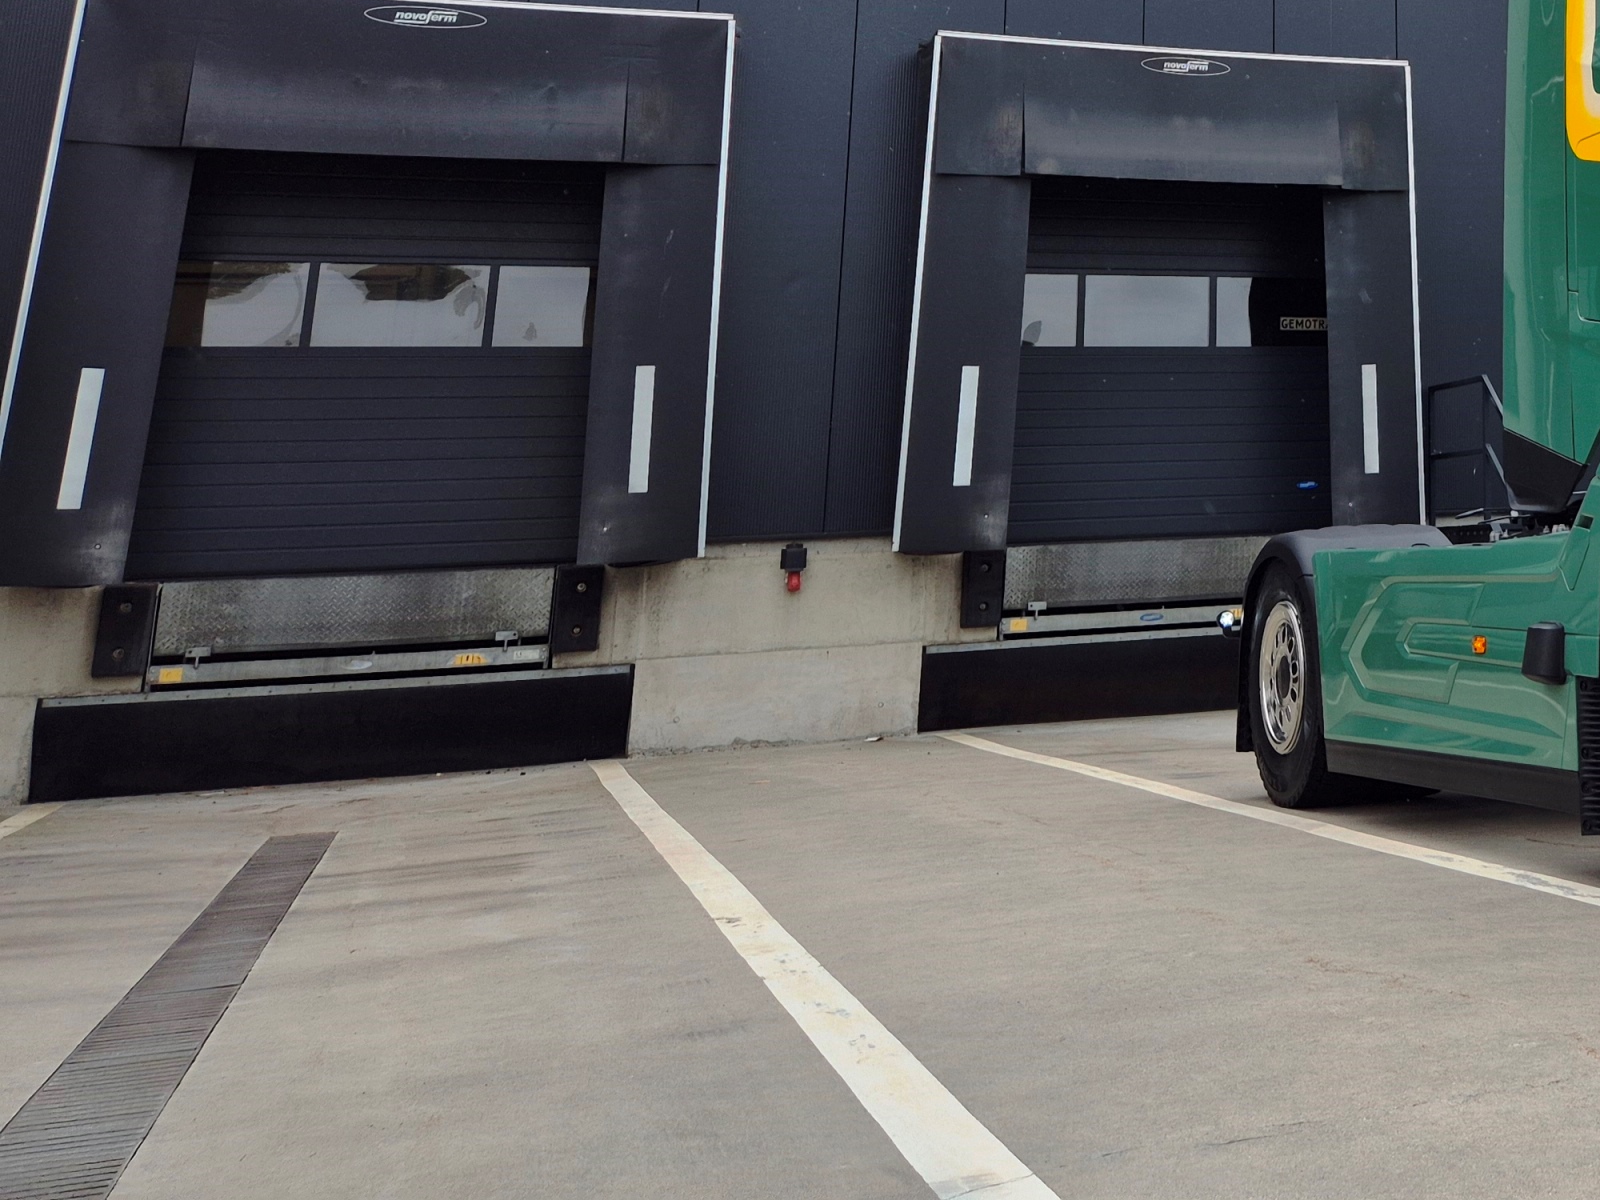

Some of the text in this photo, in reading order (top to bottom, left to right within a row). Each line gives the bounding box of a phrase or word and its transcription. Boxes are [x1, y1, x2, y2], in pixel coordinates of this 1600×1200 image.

[393, 9, 459, 25] novoferm
[1162, 60, 1210, 73] novoferm
[1281, 318, 1328, 330] GEMOTR
